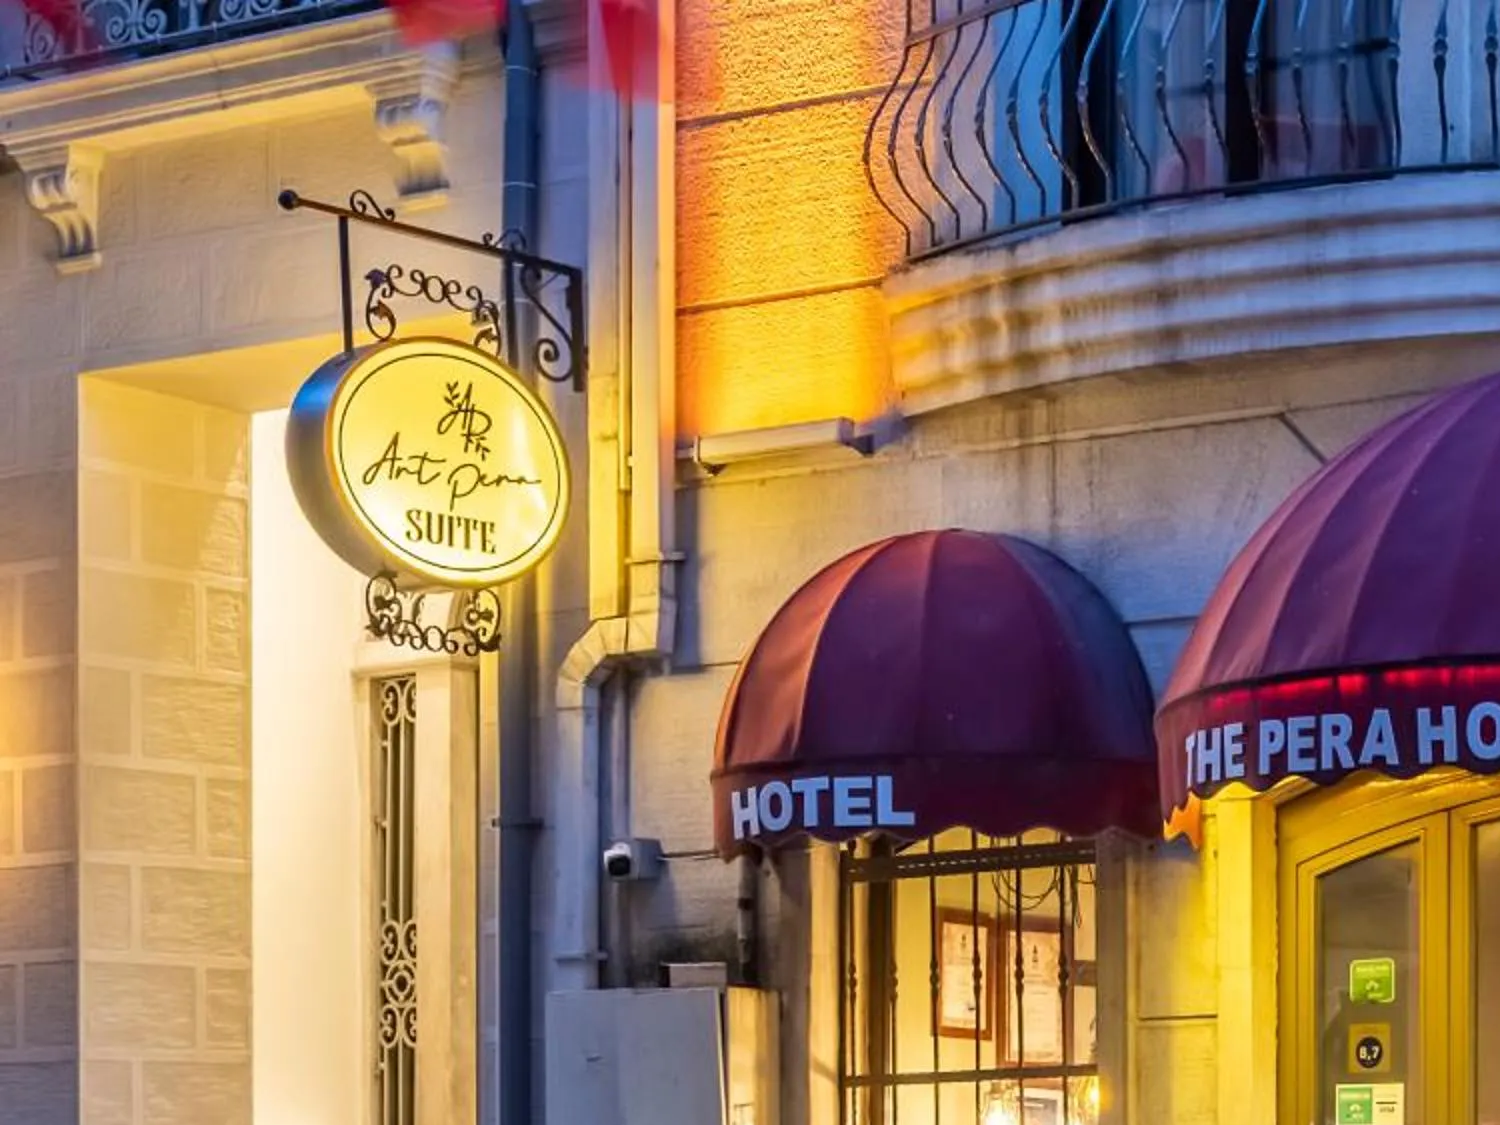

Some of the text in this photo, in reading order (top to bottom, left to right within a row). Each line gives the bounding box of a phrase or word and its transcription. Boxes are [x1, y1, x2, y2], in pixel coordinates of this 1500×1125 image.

[362, 432, 542, 512] Art Pera
[405, 509, 497, 555] SUITE
[1185, 722, 1244, 788] THE
[1258, 708, 1399, 776] PERA
[731, 775, 916, 840] HOTEL
